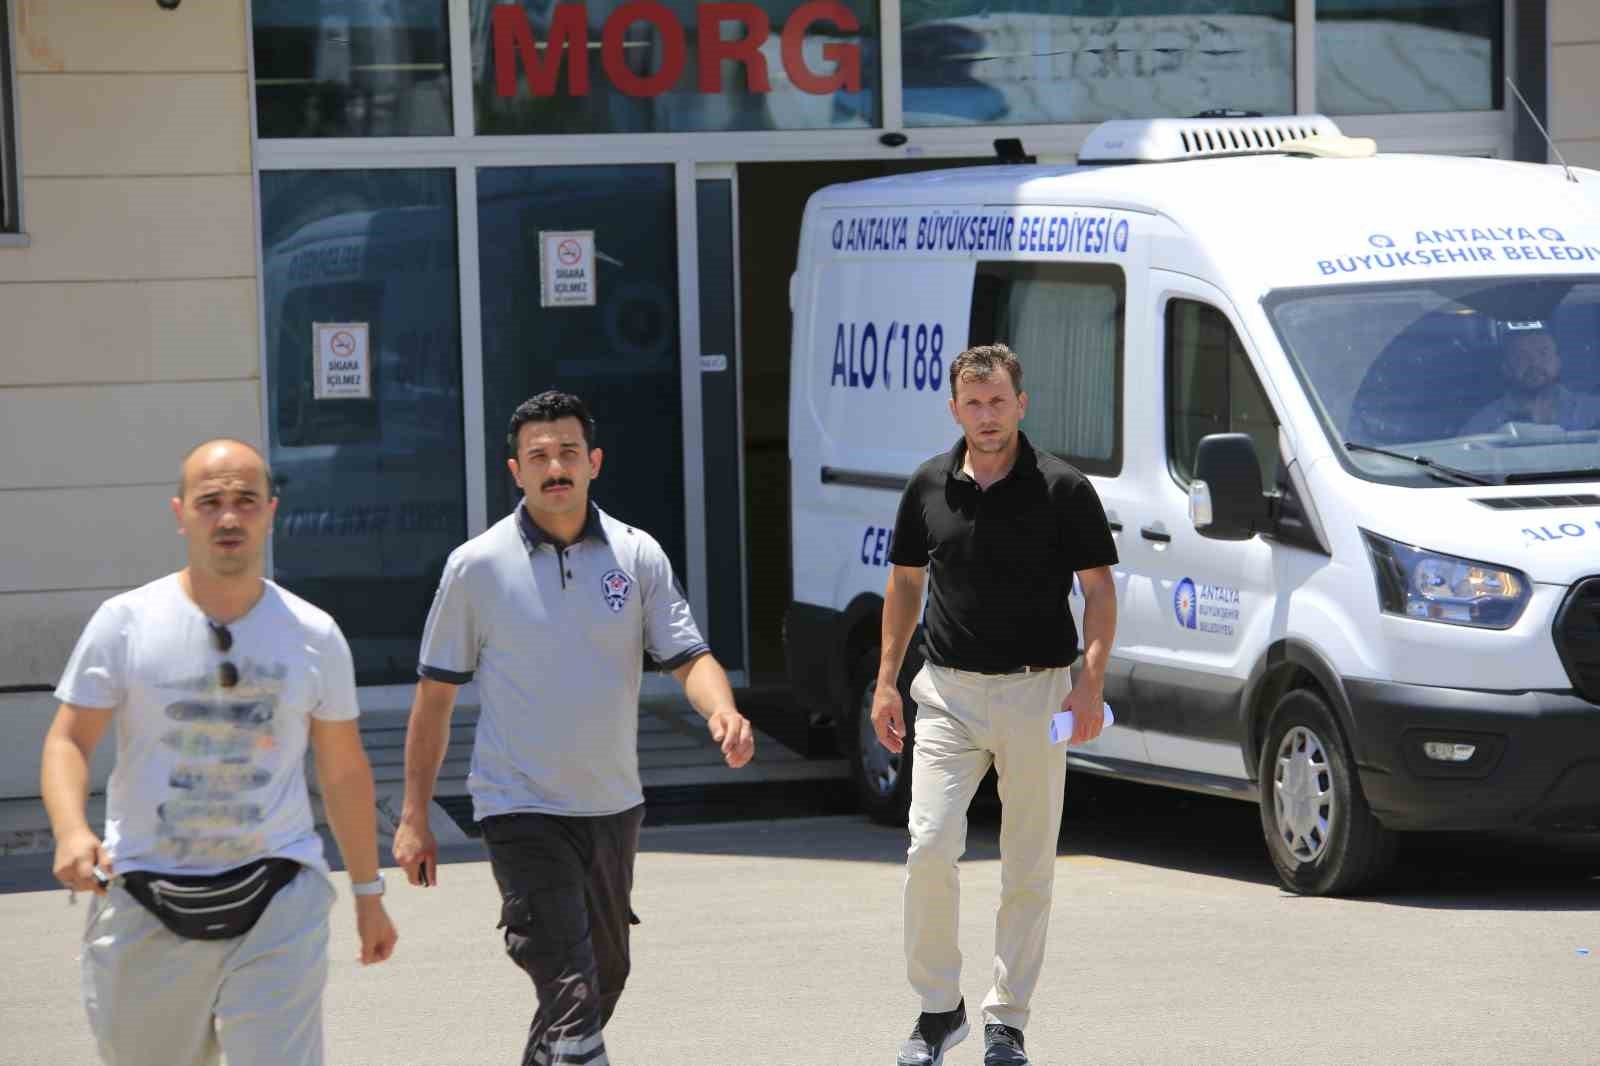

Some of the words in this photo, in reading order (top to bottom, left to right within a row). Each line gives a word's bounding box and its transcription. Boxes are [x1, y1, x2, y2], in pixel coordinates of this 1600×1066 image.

[490, 0, 862, 97] MORG
[846, 216, 908, 251] ANTALYA
[917, 209, 1015, 256] BÜYÜKŞEHİR
[1019, 211, 1113, 253] BELEDİYESİ
[1415, 227, 1536, 244] ANTALYA
[831, 321, 878, 389] ALO
[901, 323, 944, 391] 188
[1199, 583, 1240, 604] ANTALYA
